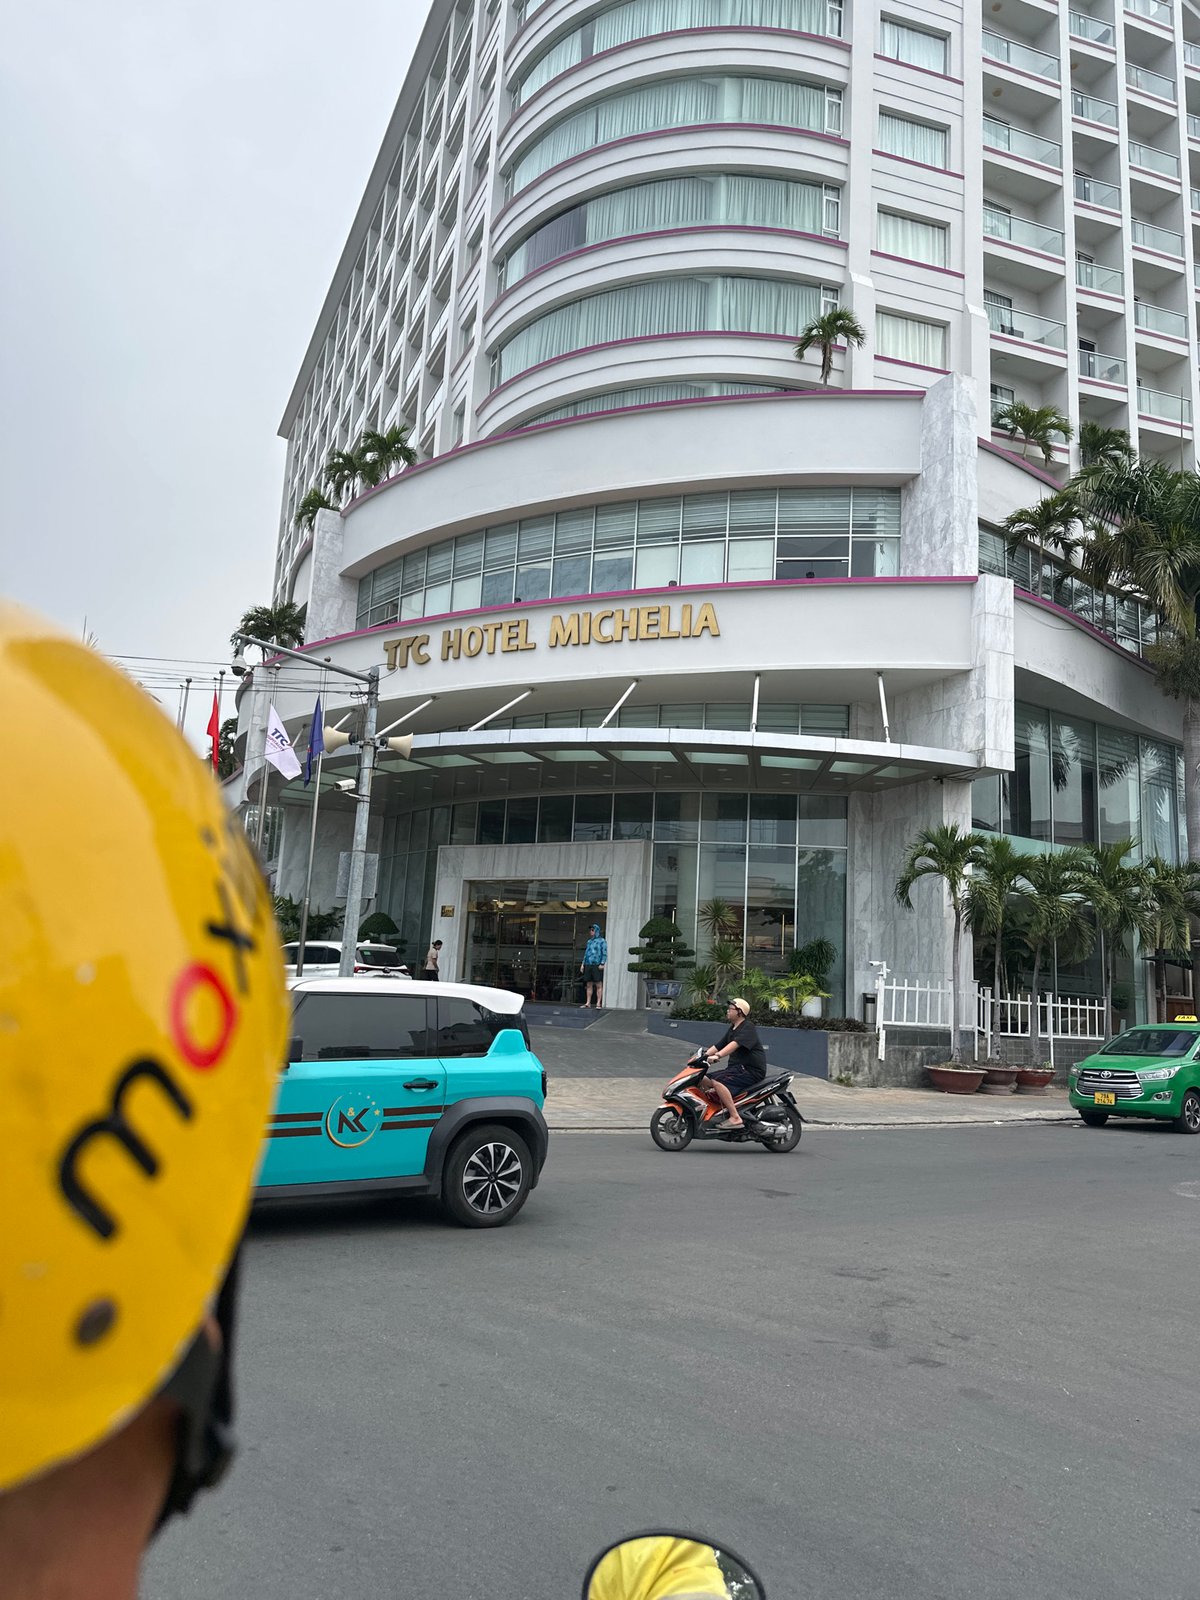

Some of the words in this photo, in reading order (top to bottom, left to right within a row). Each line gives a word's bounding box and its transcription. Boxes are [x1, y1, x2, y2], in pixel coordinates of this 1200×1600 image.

[383, 634, 431, 670] TTC
[440, 618, 536, 661] HOTEL
[548, 602, 721, 648] MICHELIA
[271, 727, 288, 746] TTC
